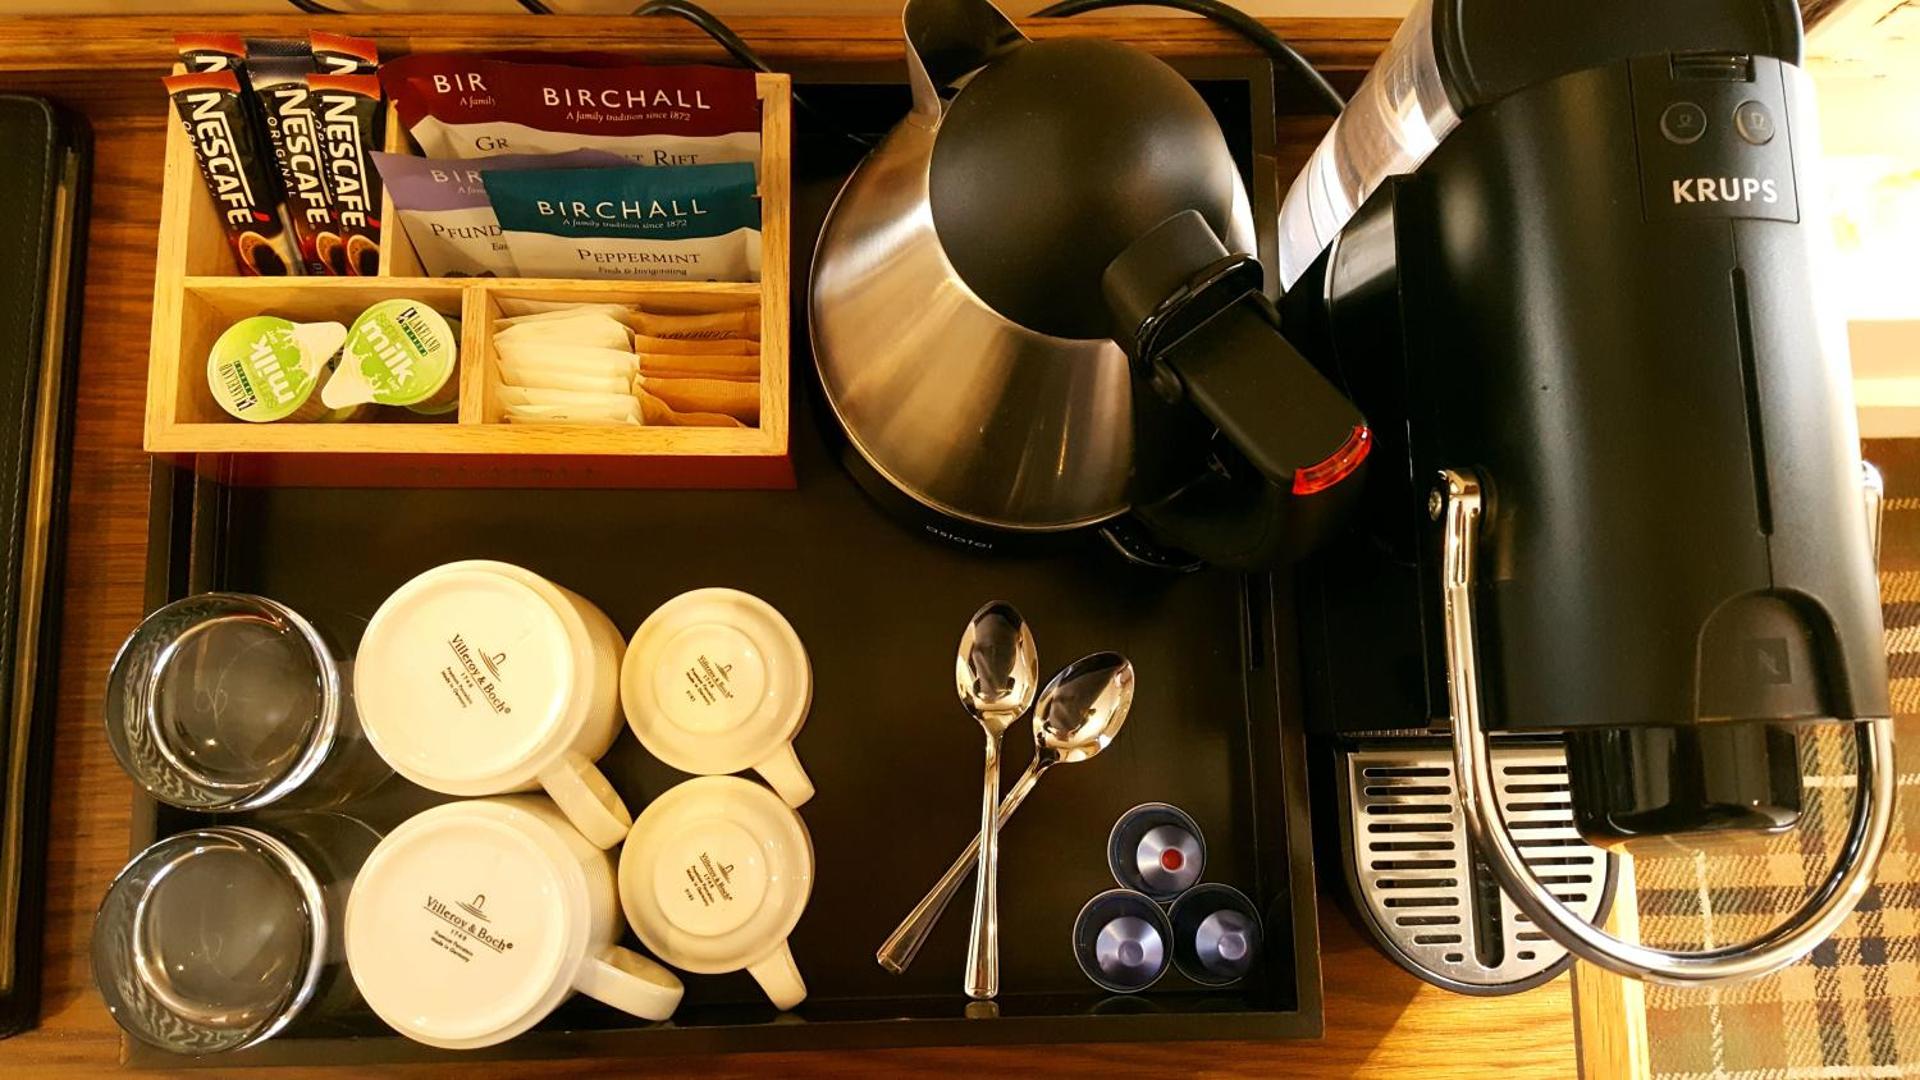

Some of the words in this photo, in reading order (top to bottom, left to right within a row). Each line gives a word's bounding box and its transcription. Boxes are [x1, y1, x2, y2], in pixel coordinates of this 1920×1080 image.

[433, 73, 487, 93] BIR
[543, 88, 711, 109] BIRCHALL
[566, 112, 574, 120] A
[576, 111, 603, 123] family
[606, 113, 643, 121] tradition
[646, 111, 667, 120] since
[670, 111, 691, 121] 1872
[267, 116, 297, 198] ORIGINAL
[653, 150, 699, 166] RIFT
[1672, 177, 1778, 204] KRUPS
[537, 199, 708, 219] BIRCHALL
[572, 219, 600, 228] family
[642, 221, 664, 229] since
[577, 248, 701, 264] PEPPERMINT
[360, 320, 414, 386] milk
[250, 334, 296, 403] milk
[452, 634, 480, 676] Villeroy
[477, 676, 486, 685] &
[427, 896, 468, 927] Villeroy
